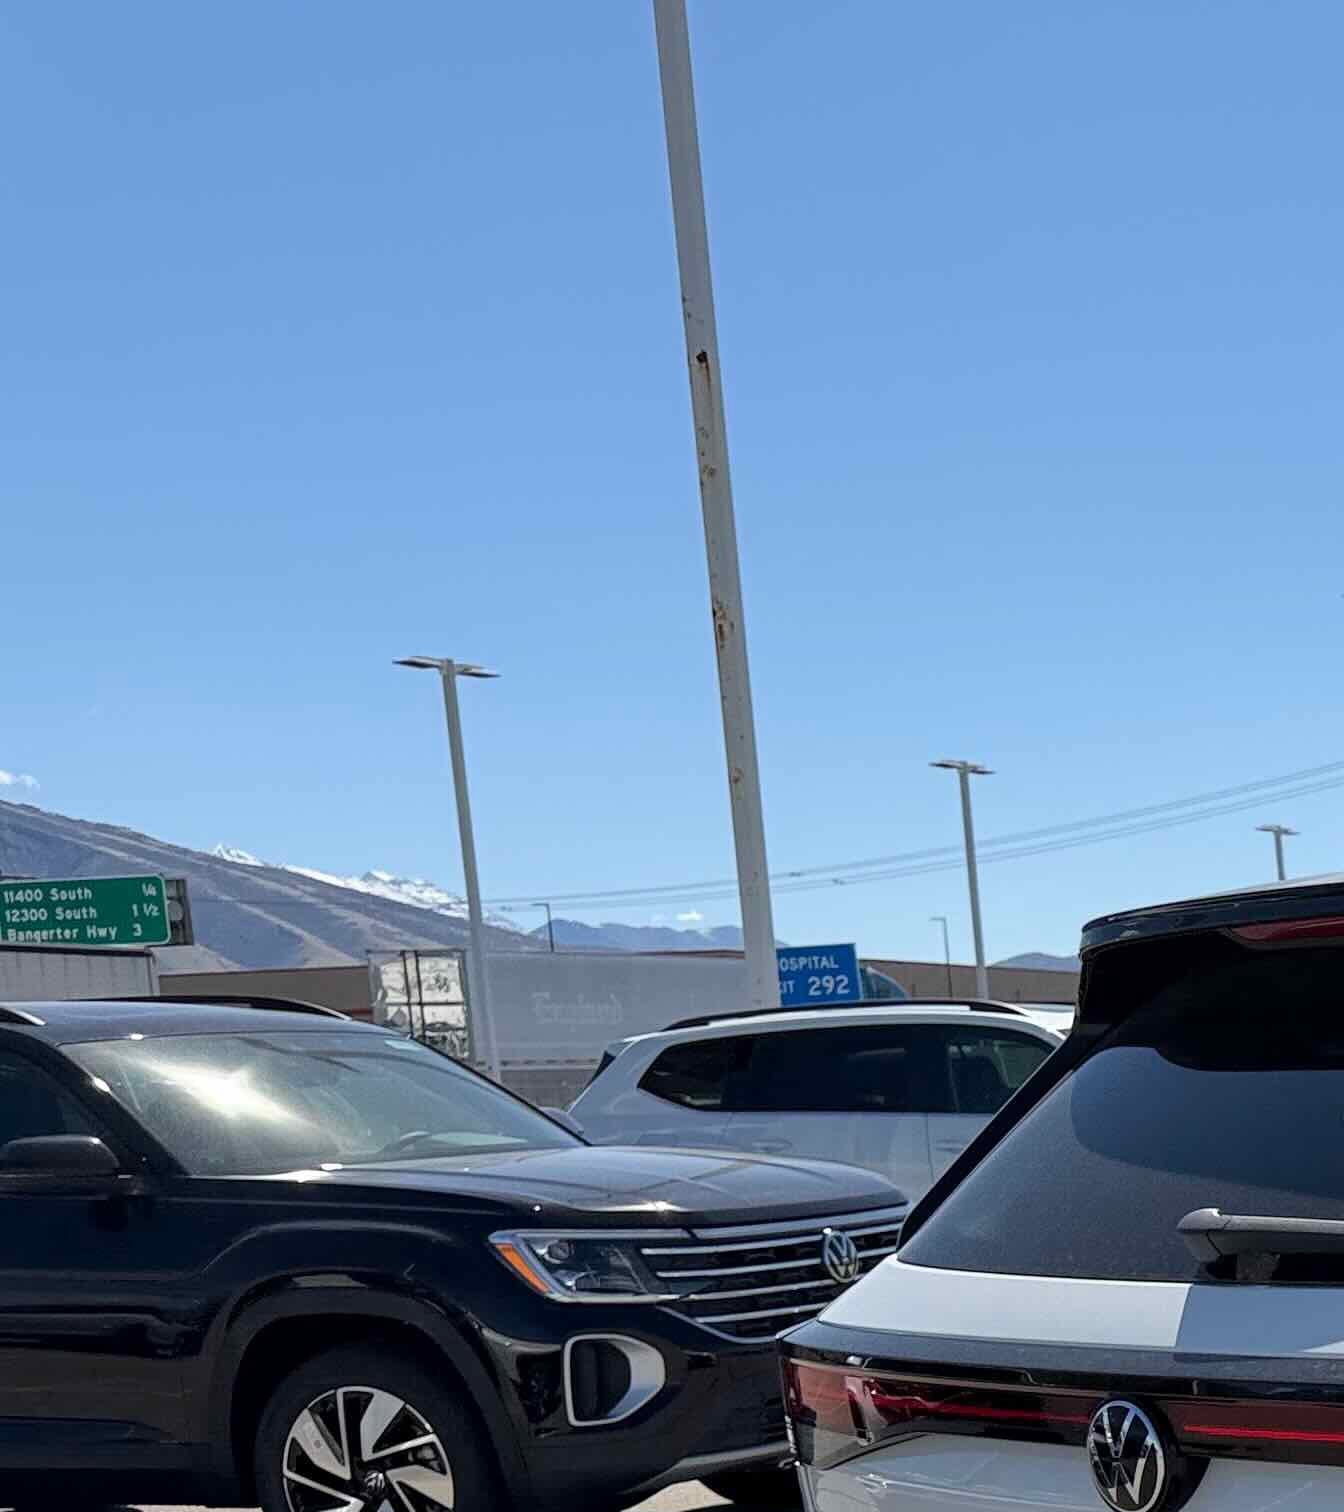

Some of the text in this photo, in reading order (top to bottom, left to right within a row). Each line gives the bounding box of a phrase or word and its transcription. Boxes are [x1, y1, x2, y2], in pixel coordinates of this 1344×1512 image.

[3, 889, 43, 904] 11400
[50, 887, 93, 901] South
[5, 908, 48, 923] 12300
[55, 905, 98, 920] South
[7, 923, 142, 944] Bangerter Hwy 3
[780, 956, 839, 972] OSPITAL
[807, 974, 850, 996] 292
